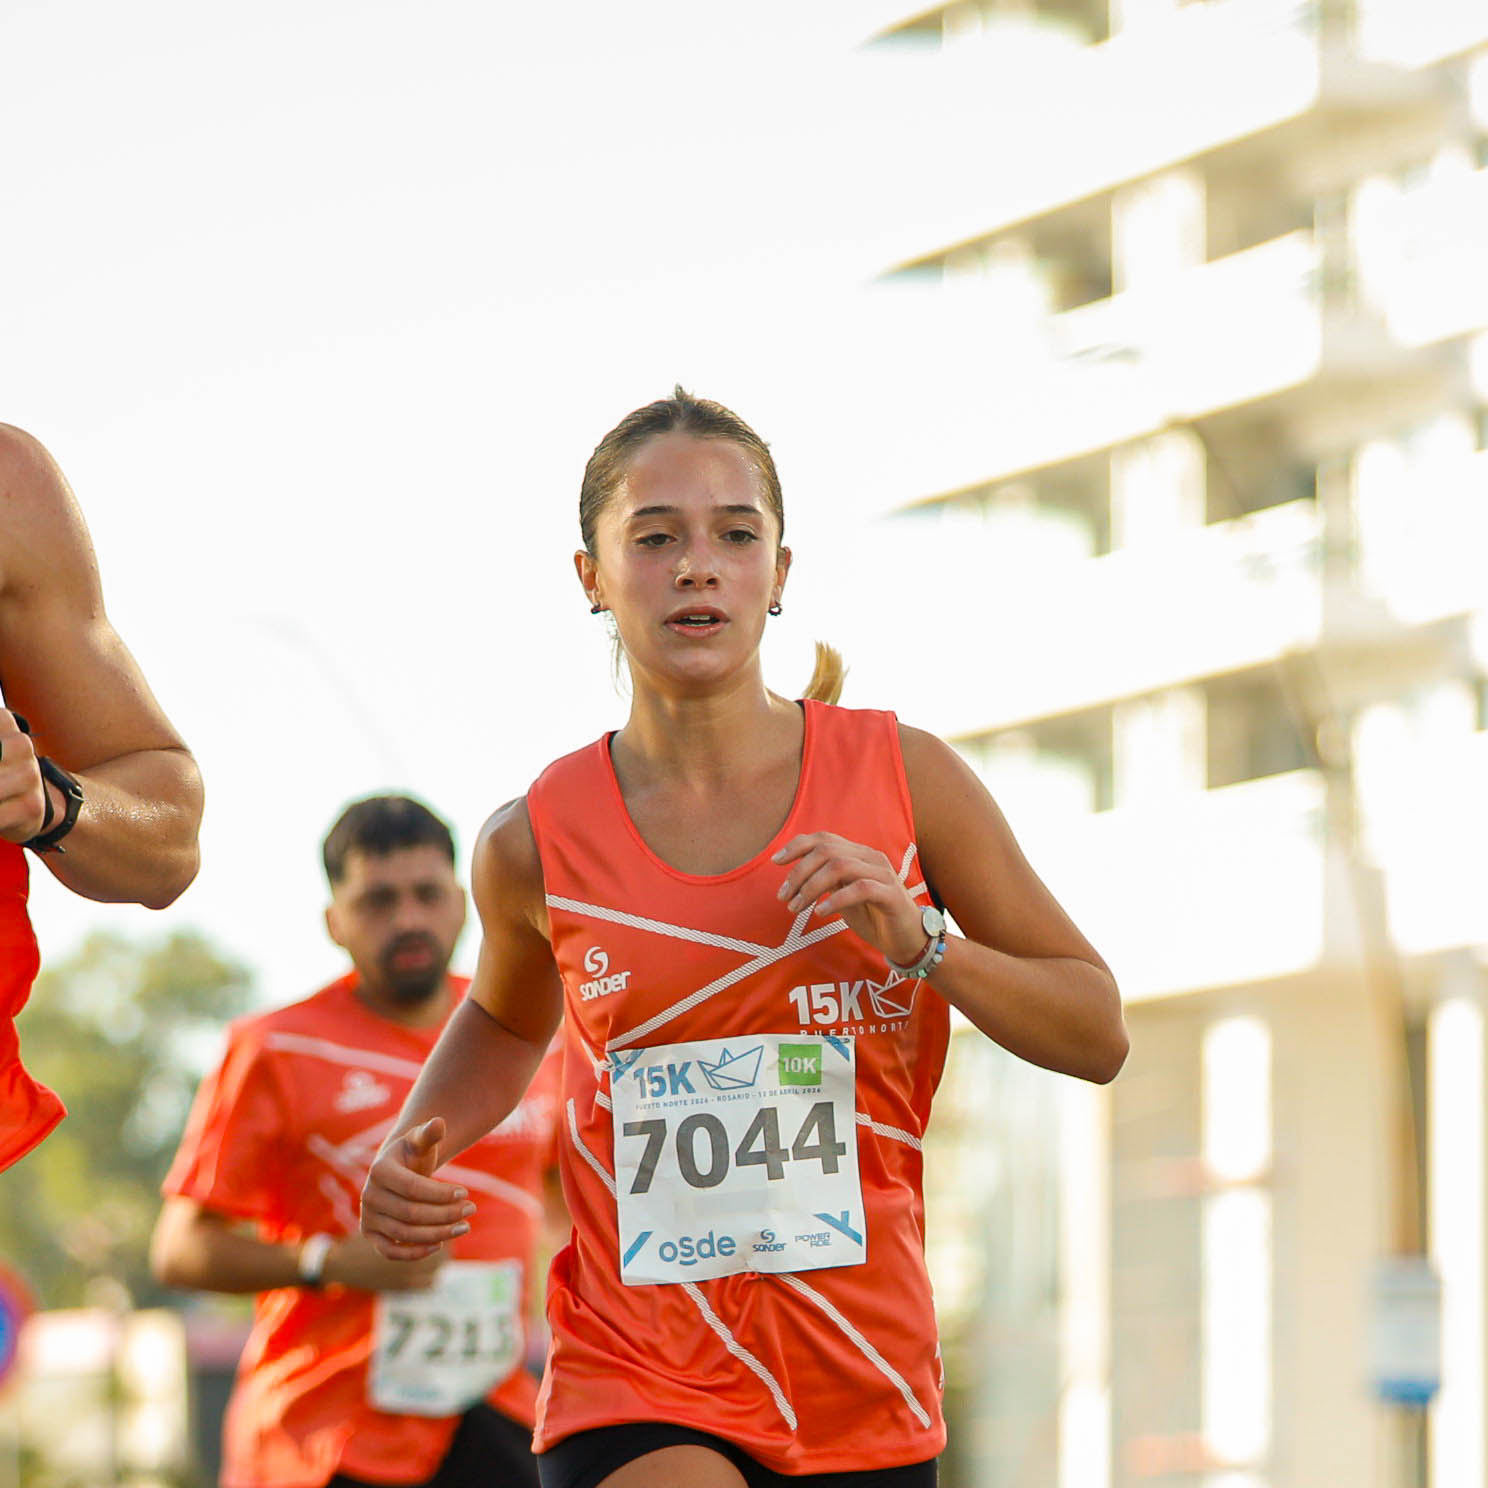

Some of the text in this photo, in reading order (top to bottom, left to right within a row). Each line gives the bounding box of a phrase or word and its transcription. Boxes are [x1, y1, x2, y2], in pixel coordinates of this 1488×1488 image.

[788, 980, 865, 1025] 15K
[633, 1061, 696, 1099] 15K
[783, 1057, 817, 1074] 10K
[717, 1092, 750, 1102] ROSARIO
[623, 1101, 847, 1194] 7044
[658, 1229, 737, 1266] osde
